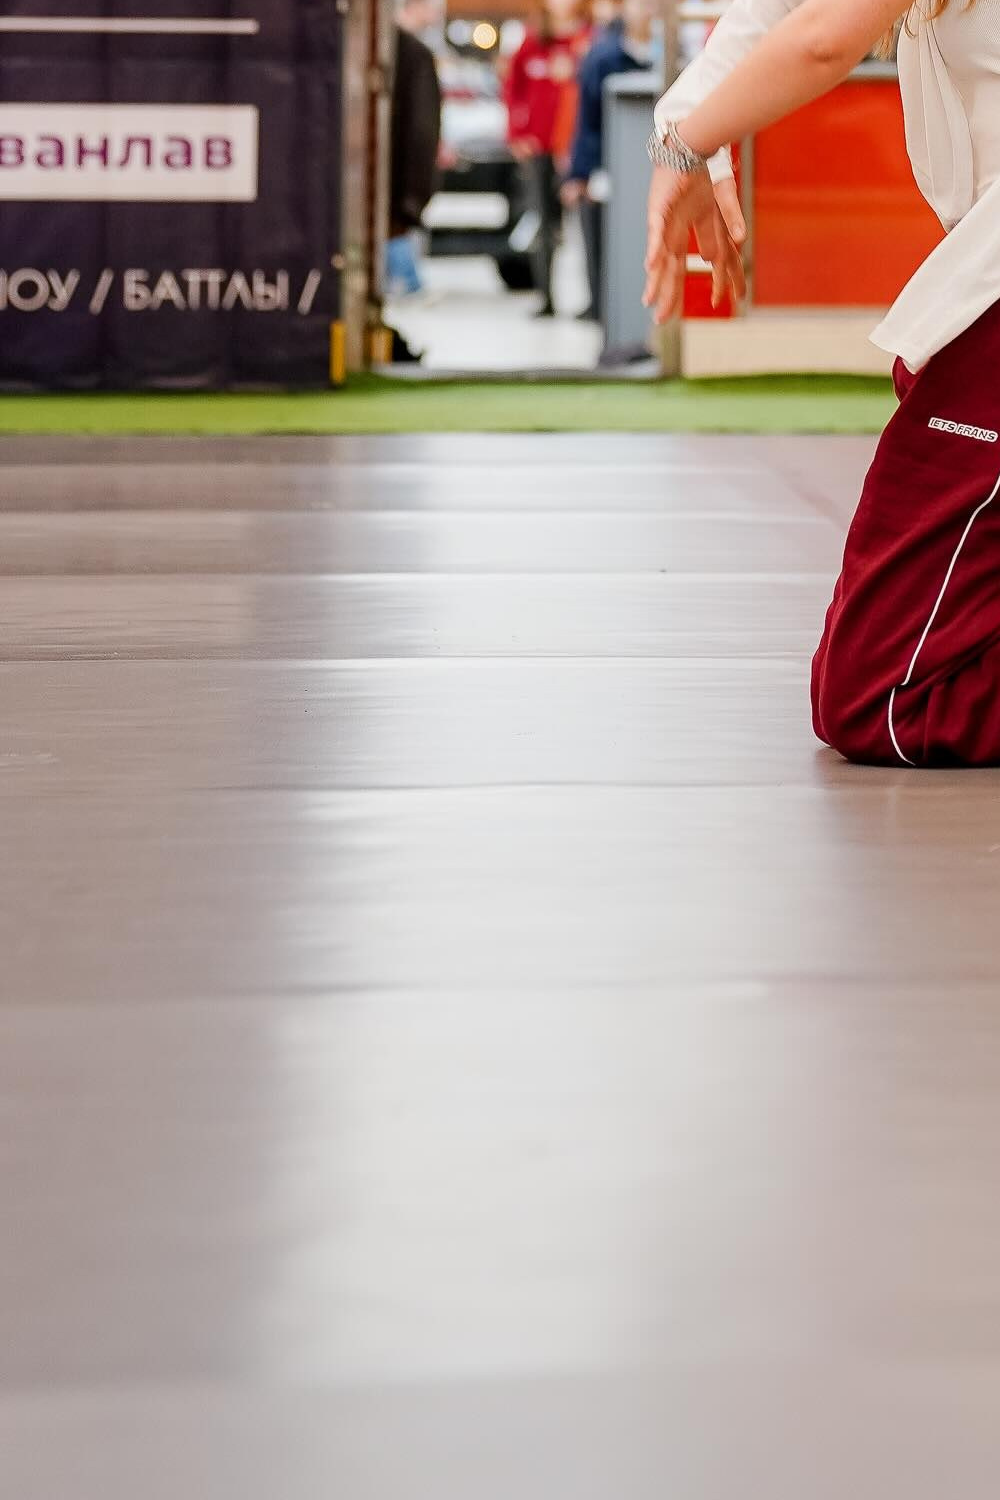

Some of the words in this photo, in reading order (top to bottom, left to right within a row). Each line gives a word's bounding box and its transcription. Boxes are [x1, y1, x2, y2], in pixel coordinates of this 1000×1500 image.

[0, 268, 81, 312] ОУ
[123, 268, 290, 312] БАТТЛЫ
[928, 417, 957, 432] IETS
[956, 424, 998, 442] FRANS
